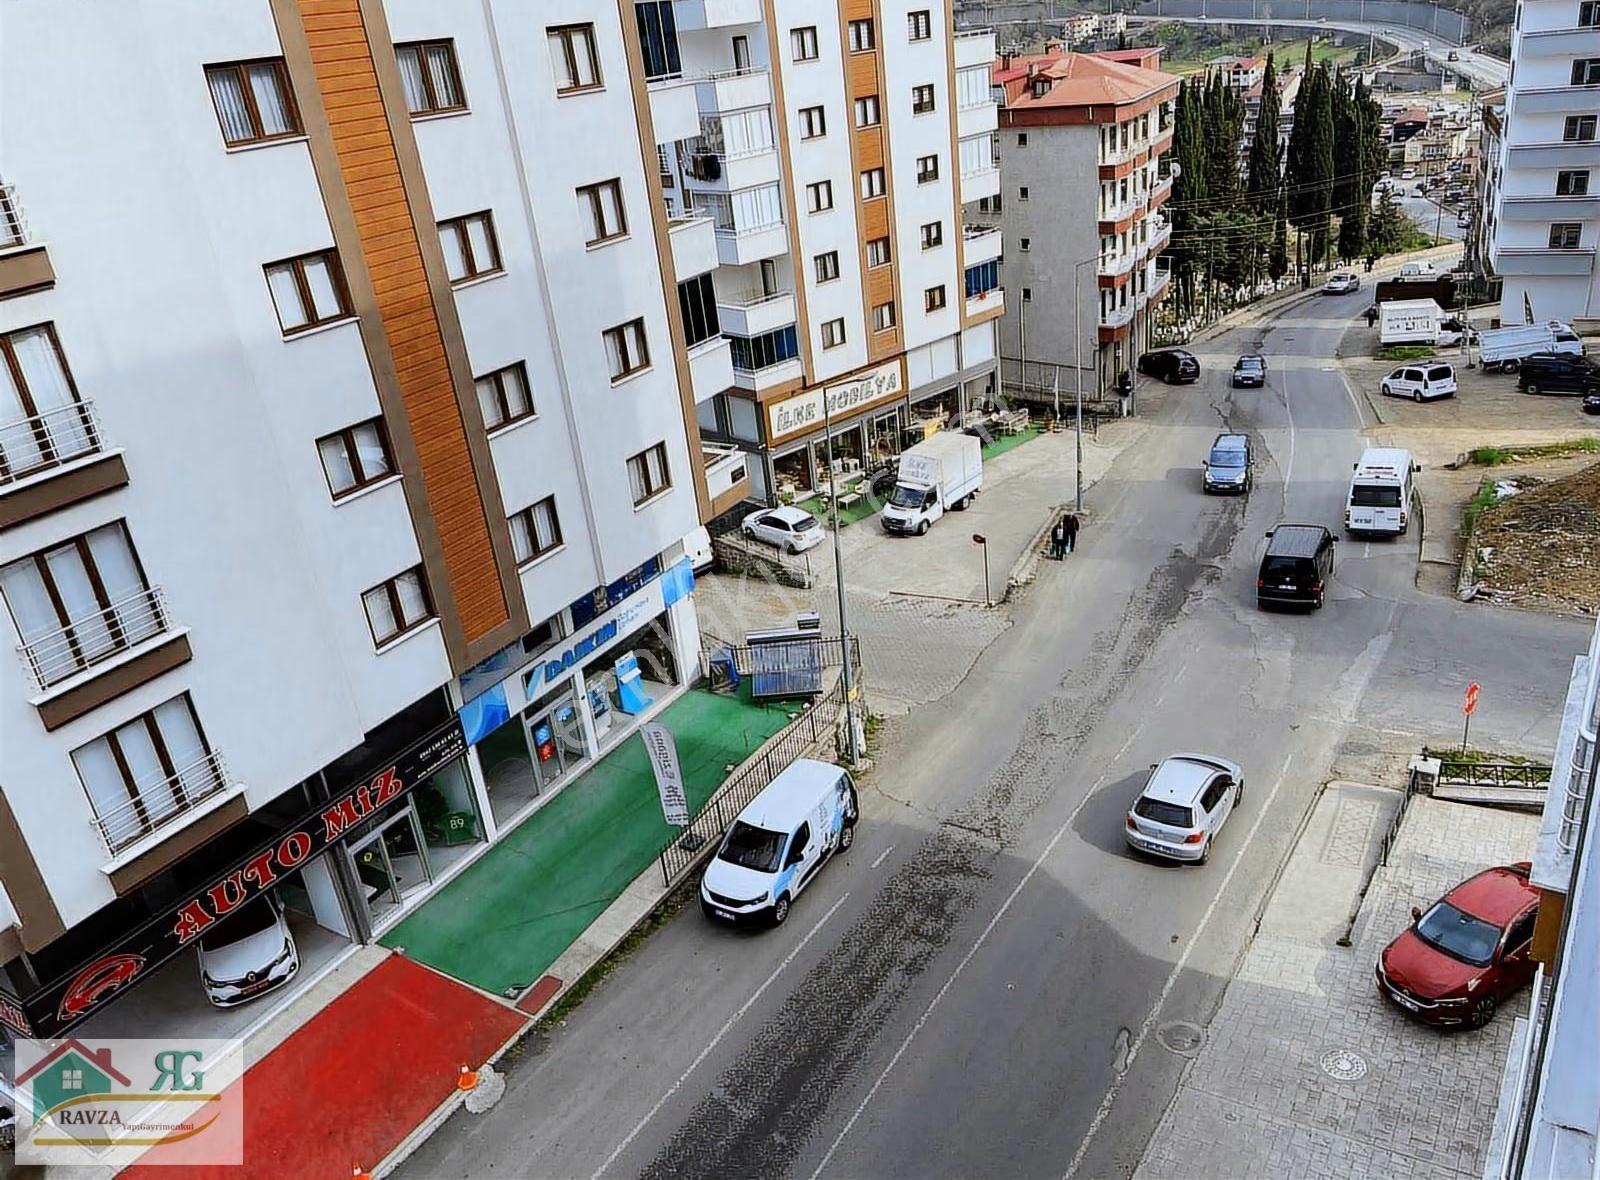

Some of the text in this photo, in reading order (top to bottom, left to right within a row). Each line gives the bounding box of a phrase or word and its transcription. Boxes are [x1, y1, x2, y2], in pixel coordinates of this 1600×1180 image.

[544, 618, 618, 684] DAIKIN
[450, 818, 464, 829] 89
[174, 831, 312, 944] AUTO
